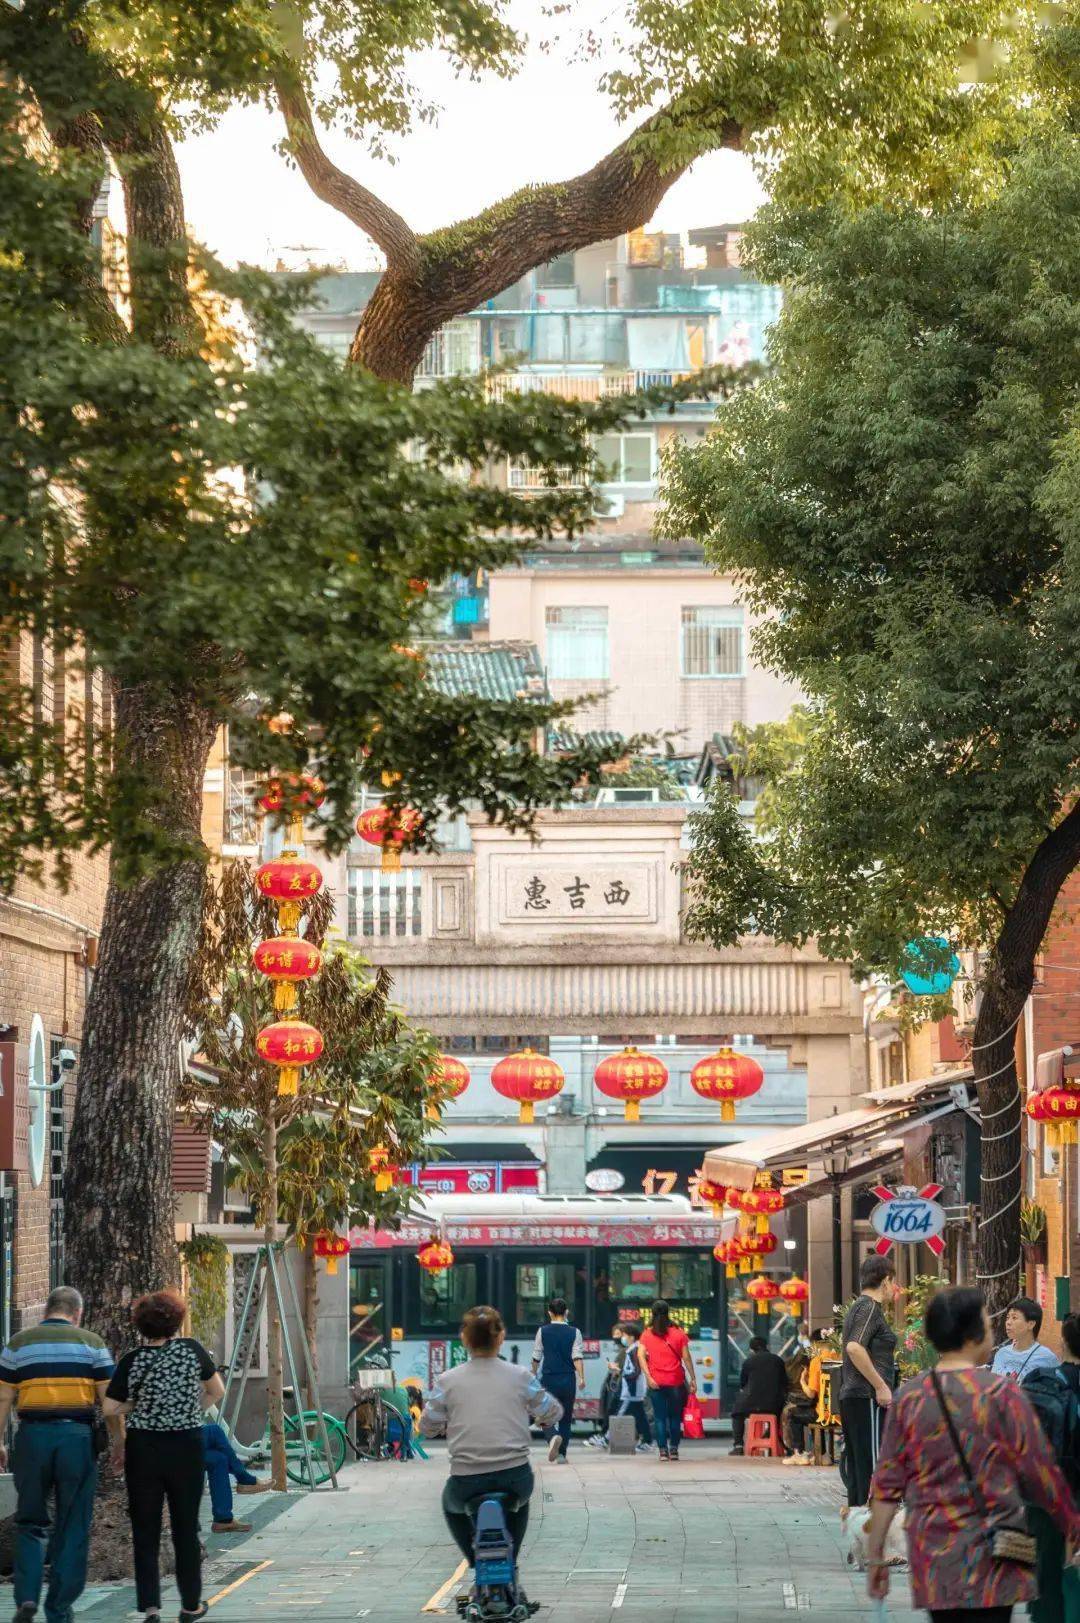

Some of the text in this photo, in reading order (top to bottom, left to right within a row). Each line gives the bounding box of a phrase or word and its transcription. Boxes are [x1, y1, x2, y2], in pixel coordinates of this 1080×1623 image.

[524, 876, 631, 911] 惠吉西
[1050, 1096, 1078, 1112] 自由
[883, 1208, 934, 1233] 1664
[617, 1308, 640, 1321] 250
